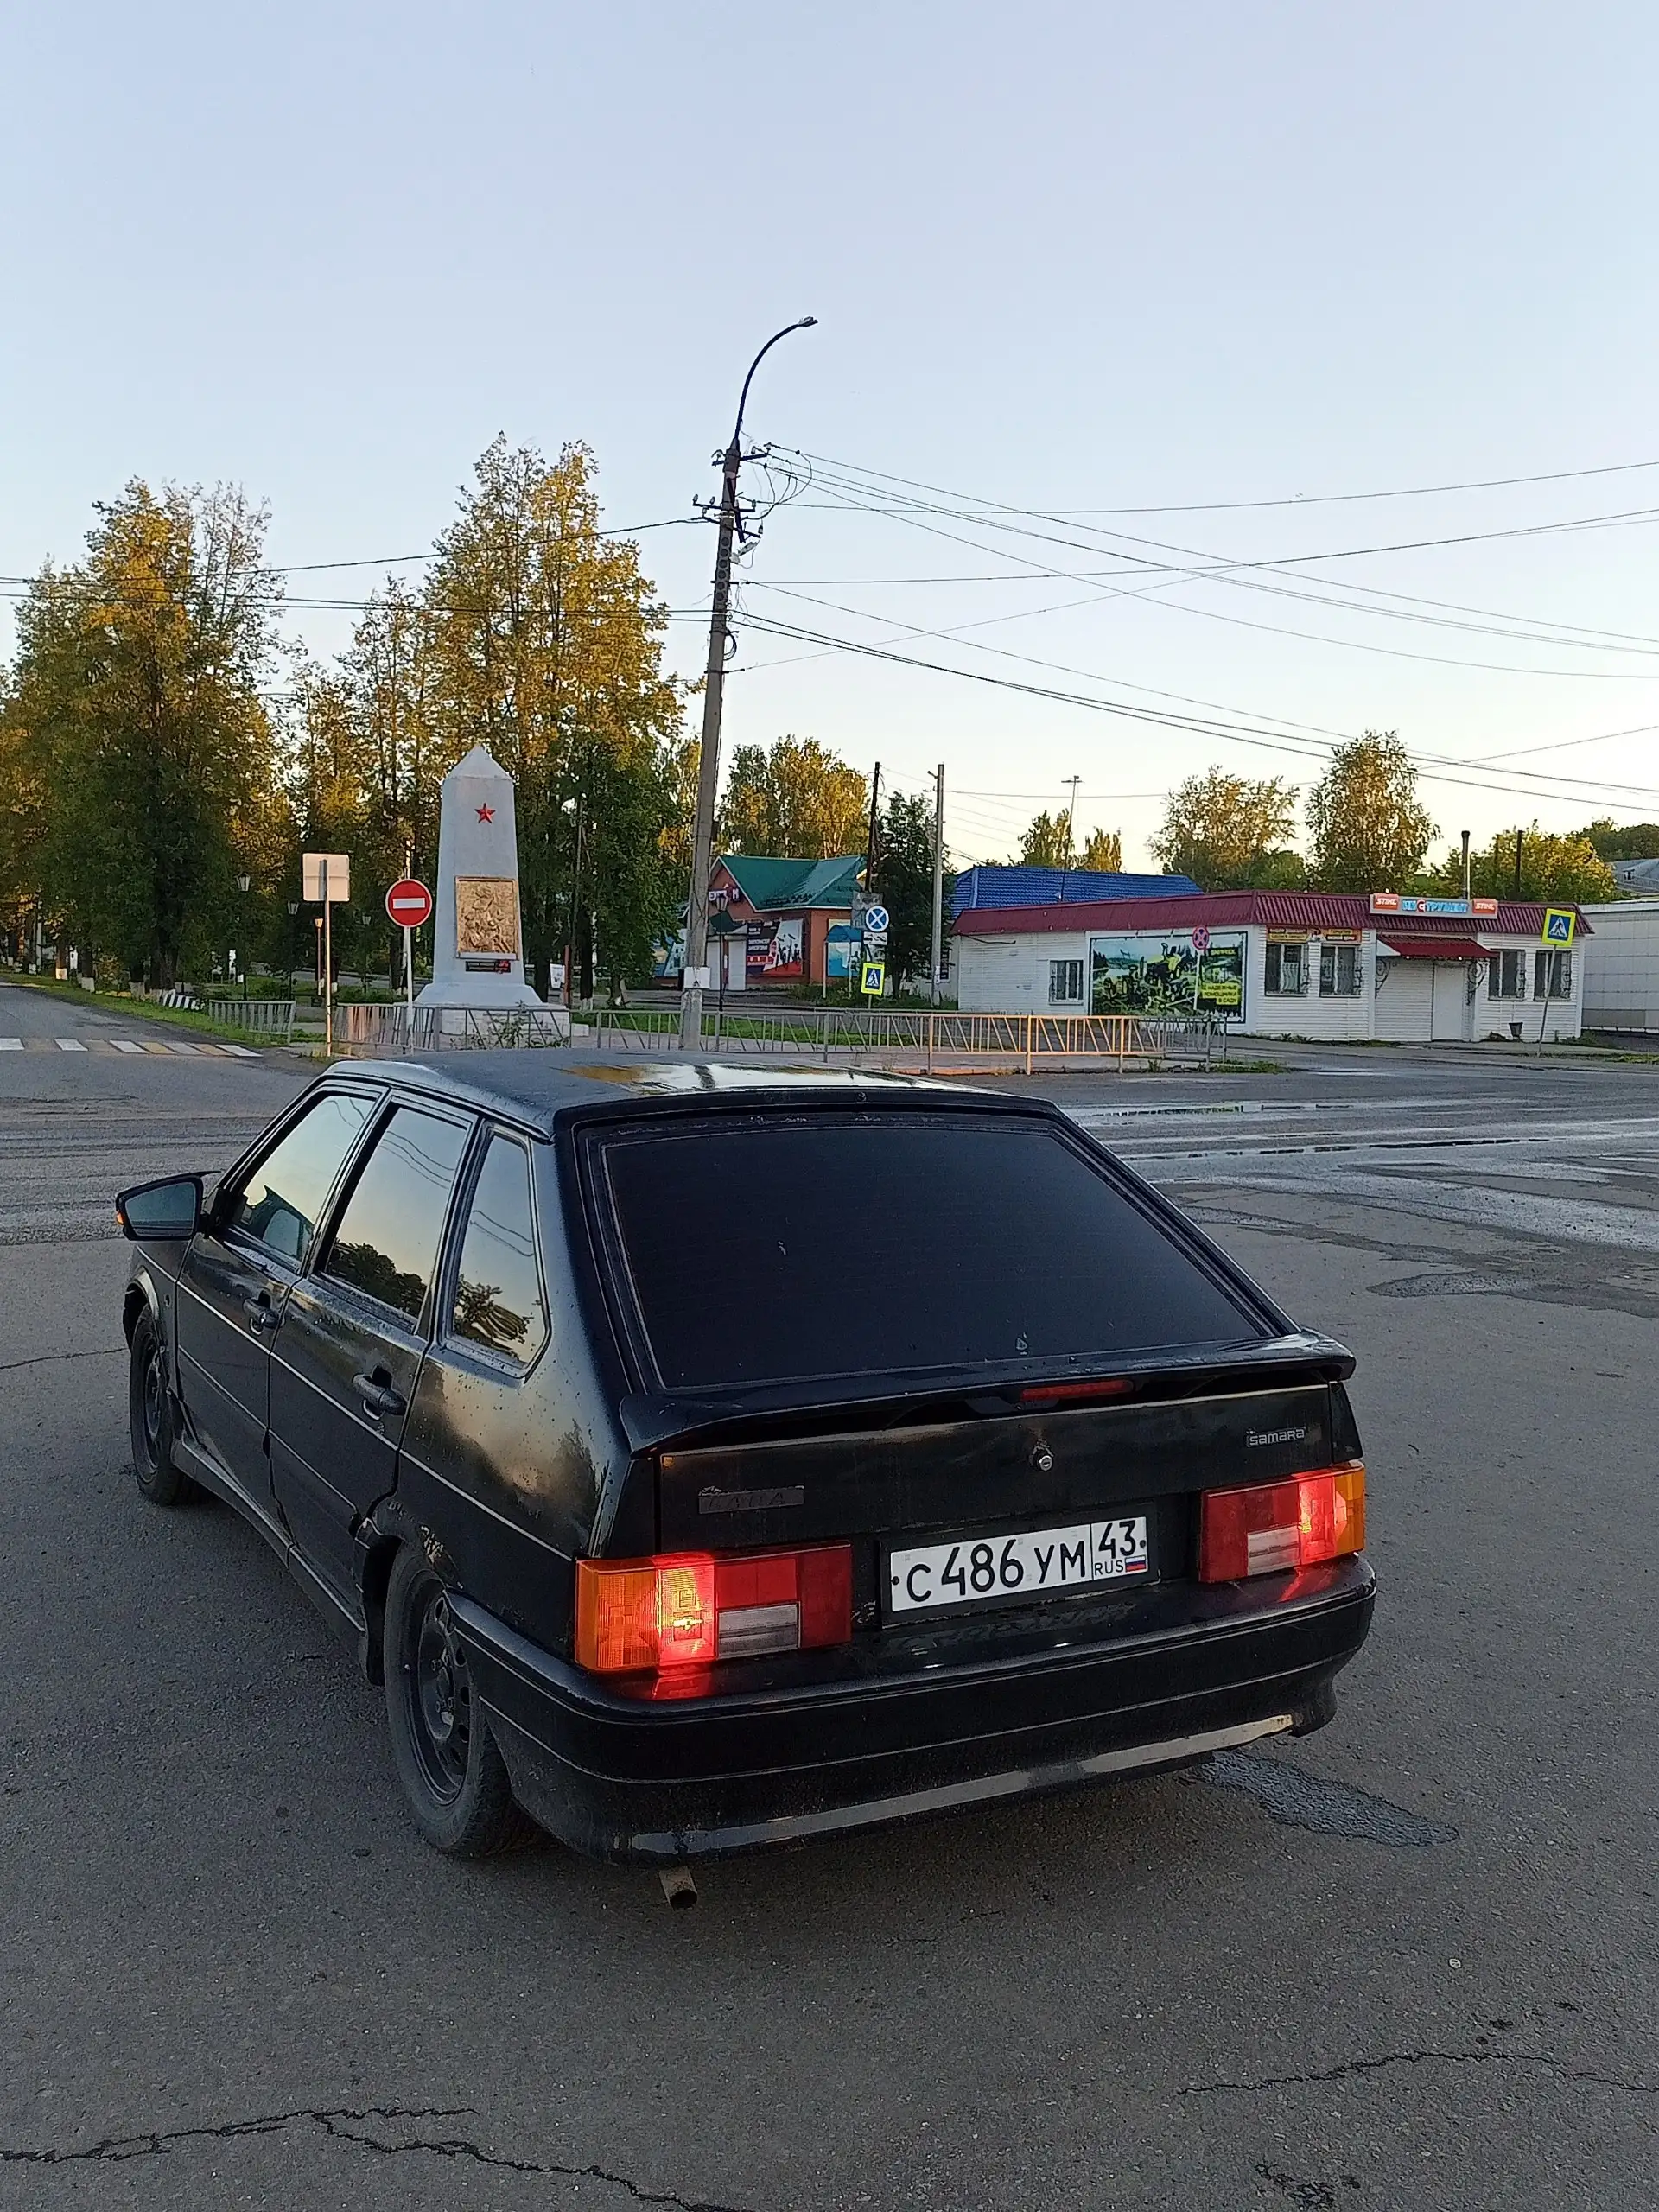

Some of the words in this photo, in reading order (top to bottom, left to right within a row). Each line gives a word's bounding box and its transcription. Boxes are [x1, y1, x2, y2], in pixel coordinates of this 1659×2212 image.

[1475, 902, 1496, 911] STIHL
[1098, 1520, 1137, 1559] 43
[1094, 1560, 1124, 1577] RUS
